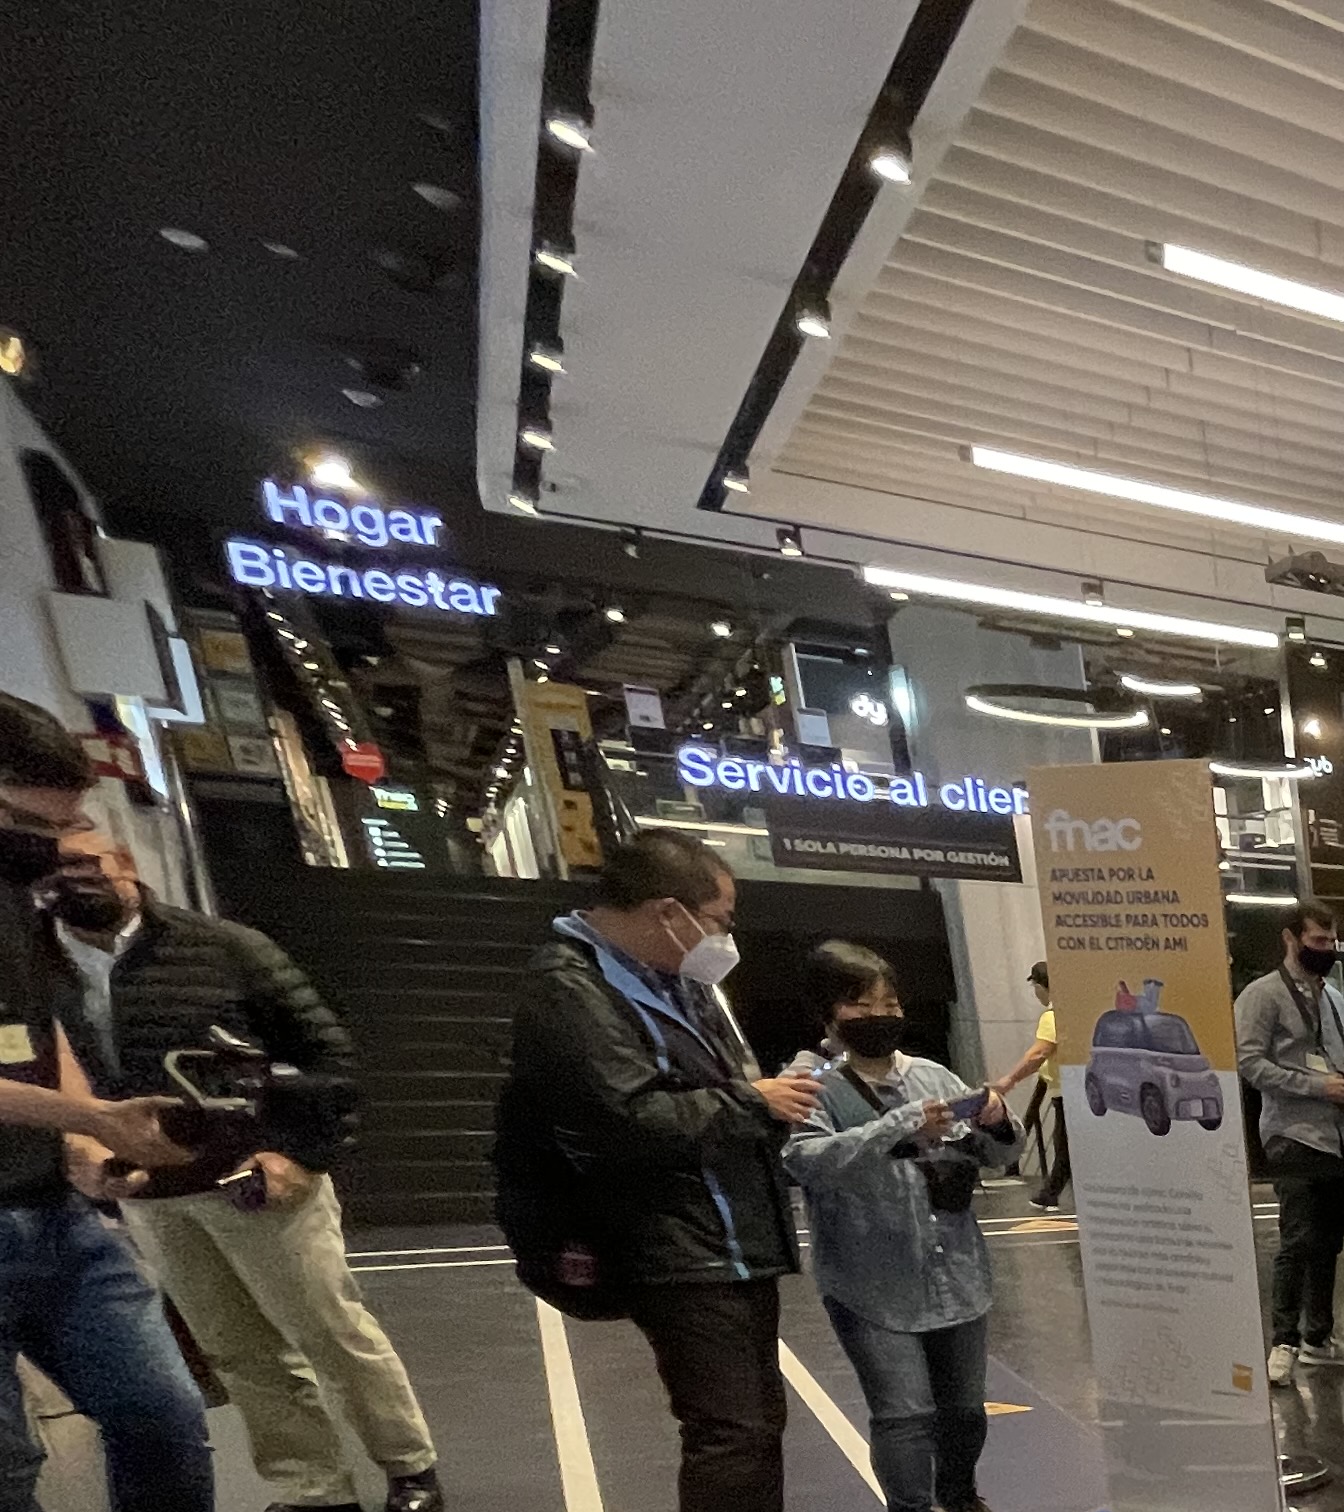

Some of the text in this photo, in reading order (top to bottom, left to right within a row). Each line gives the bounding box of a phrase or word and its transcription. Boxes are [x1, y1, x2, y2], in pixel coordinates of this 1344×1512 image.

[261, 480, 444, 547] Hogar
[227, 540, 502, 616] Bienestar
[678, 747, 876, 802] Servicio
[889, 771, 929, 807] al
[1044, 808, 1143, 852] fnac
[794, 838, 837, 855] SOLA
[839, 842, 911, 860] PERSONA
[913, 848, 945, 863] POR
[946, 850, 1009, 867] GESTIÓN
[1051, 867, 1155, 882] APUESTA POR LA
[1053, 890, 1180, 905] MOVILIDAD URBANA
[1055, 913, 1209, 928] ACCESIBLE PARA TODOS
[1057, 934, 1188, 951] CON EL CITROËN AMI
